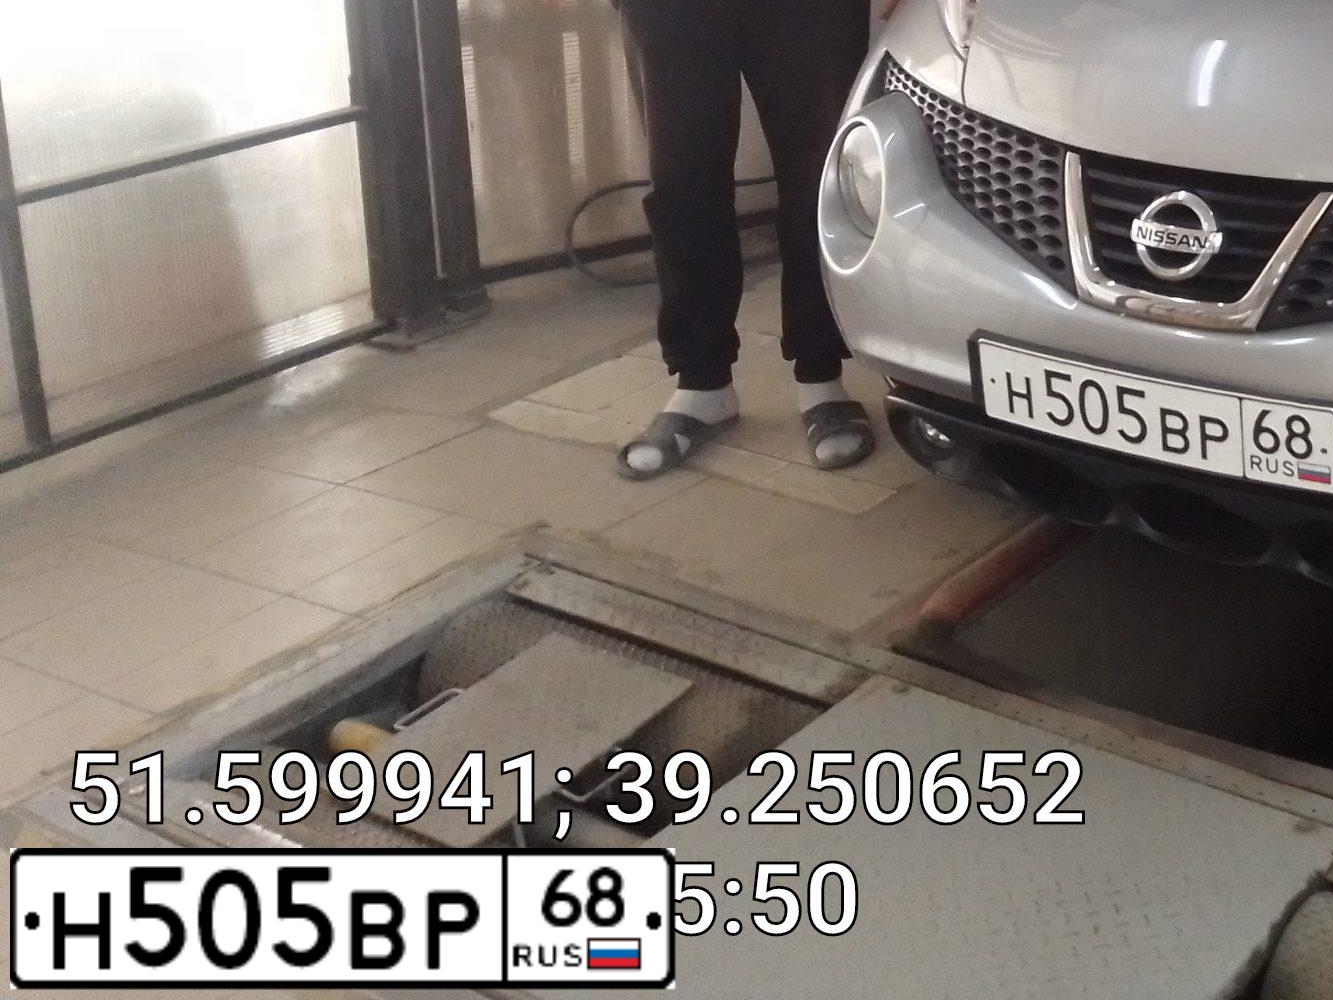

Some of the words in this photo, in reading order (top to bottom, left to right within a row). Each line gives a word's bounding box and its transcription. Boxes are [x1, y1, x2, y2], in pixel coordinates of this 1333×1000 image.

[1136, 226, 1208, 249] NISSAN
[1005, 368, 1229, 460] Н505ВР
[1252, 409, 1314, 460] 68
[1250, 454, 1295, 477] RUS
